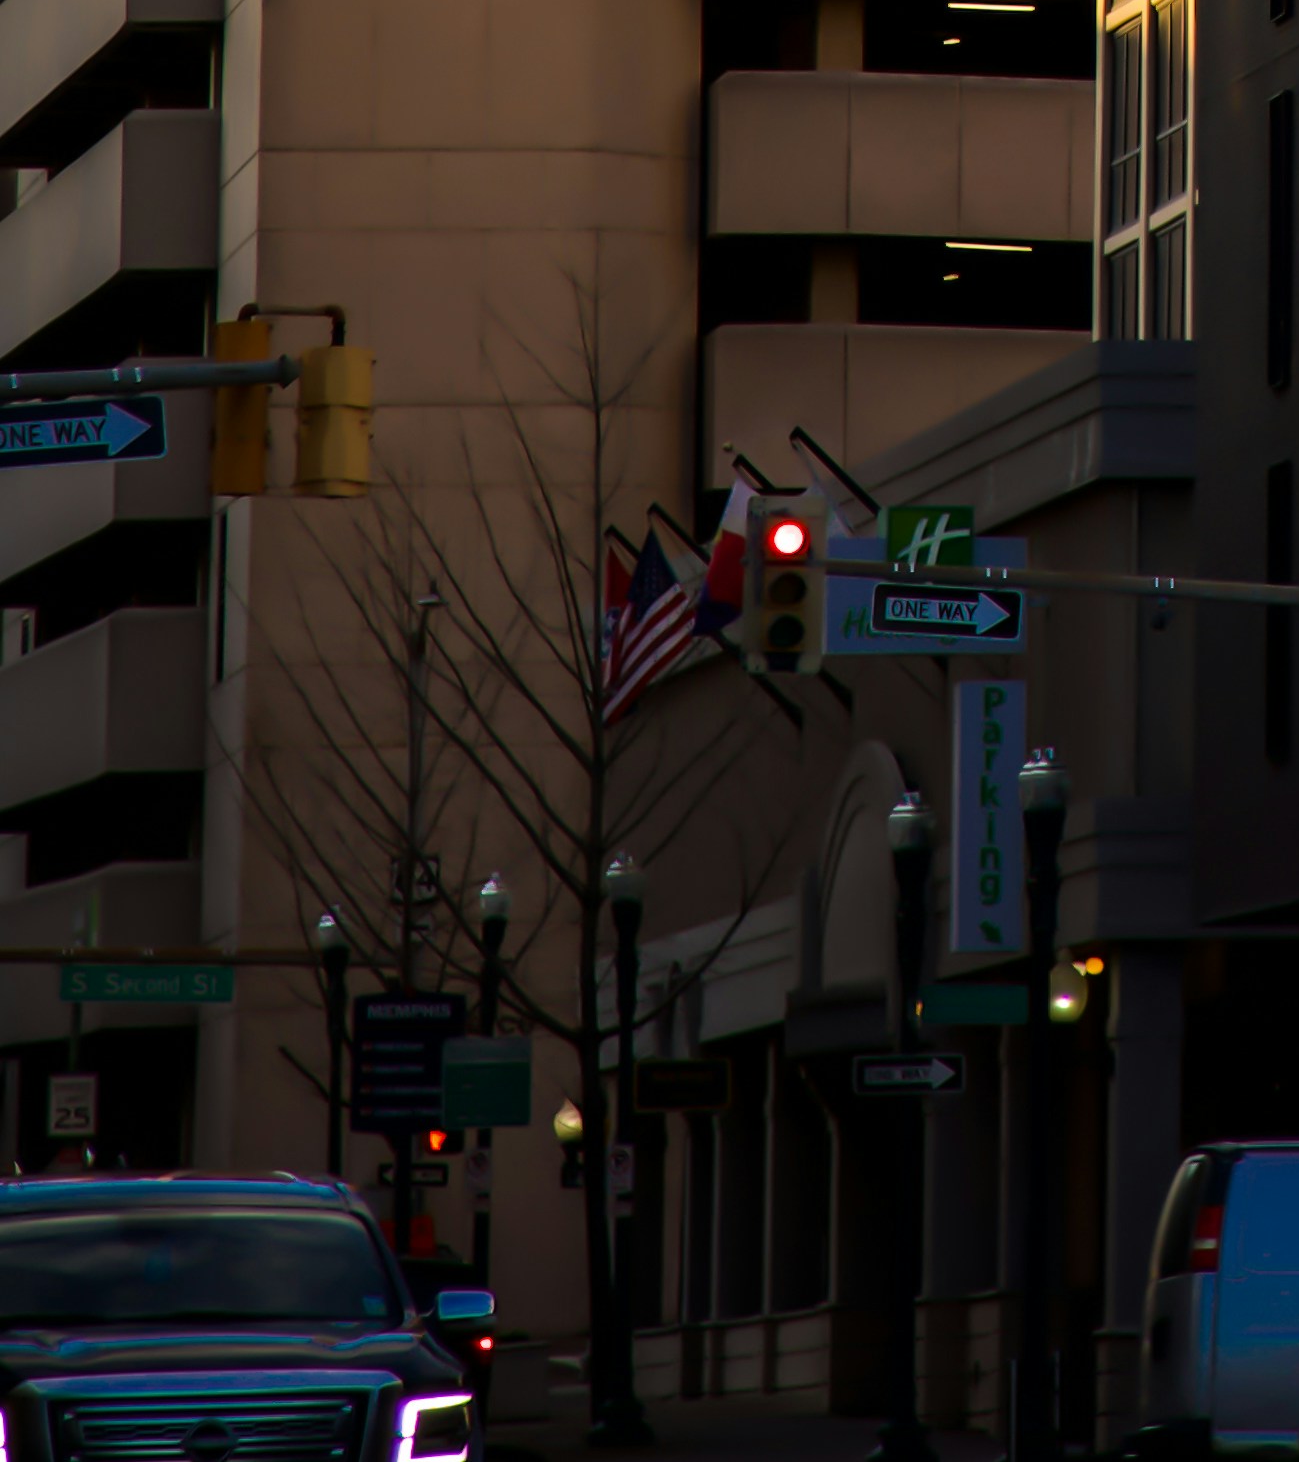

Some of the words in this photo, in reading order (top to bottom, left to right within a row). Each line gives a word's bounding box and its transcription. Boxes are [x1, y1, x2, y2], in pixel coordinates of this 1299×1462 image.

[54, 418, 106, 444] WAY
[891, 599, 930, 620] ONE
[938, 603, 978, 622] WAY
[979, 686, 1008, 906] Parking
[70, 971, 88, 994] S
[104, 971, 180, 995] Second
[192, 971, 218, 996] St
[366, 1003, 453, 1020] MEMPHIS
[54, 1106, 90, 1129] 25
